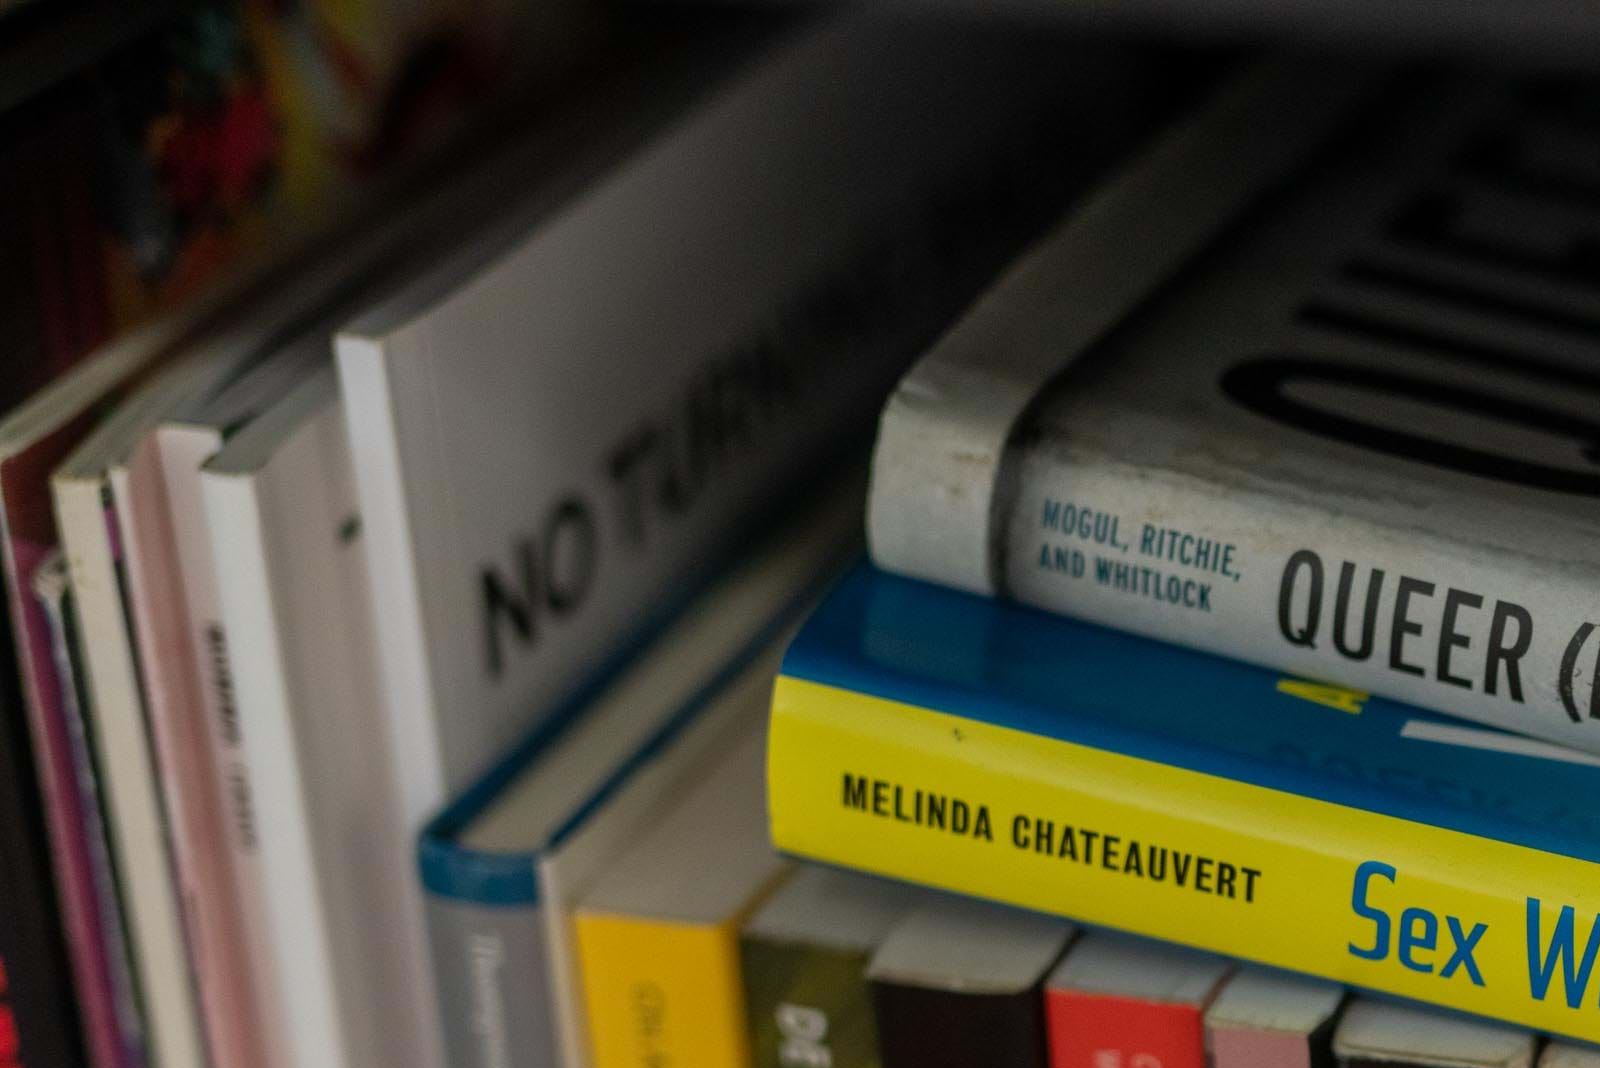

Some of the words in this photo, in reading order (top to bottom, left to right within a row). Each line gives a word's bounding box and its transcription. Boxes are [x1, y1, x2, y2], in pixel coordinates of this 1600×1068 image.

[480, 497, 597, 680] NO
[1038, 543, 1086, 580] AND
[1094, 555, 1213, 612] WHITLOCK
[1042, 498, 1129, 555] MOGUL,
[1139, 523, 1242, 583] RITCHIE,
[1276, 548, 1534, 703] QUEER
[840, 772, 995, 842] MELINDA
[1010, 813, 1263, 905] CHATEAUVERT
[1348, 860, 1489, 988] Sex
